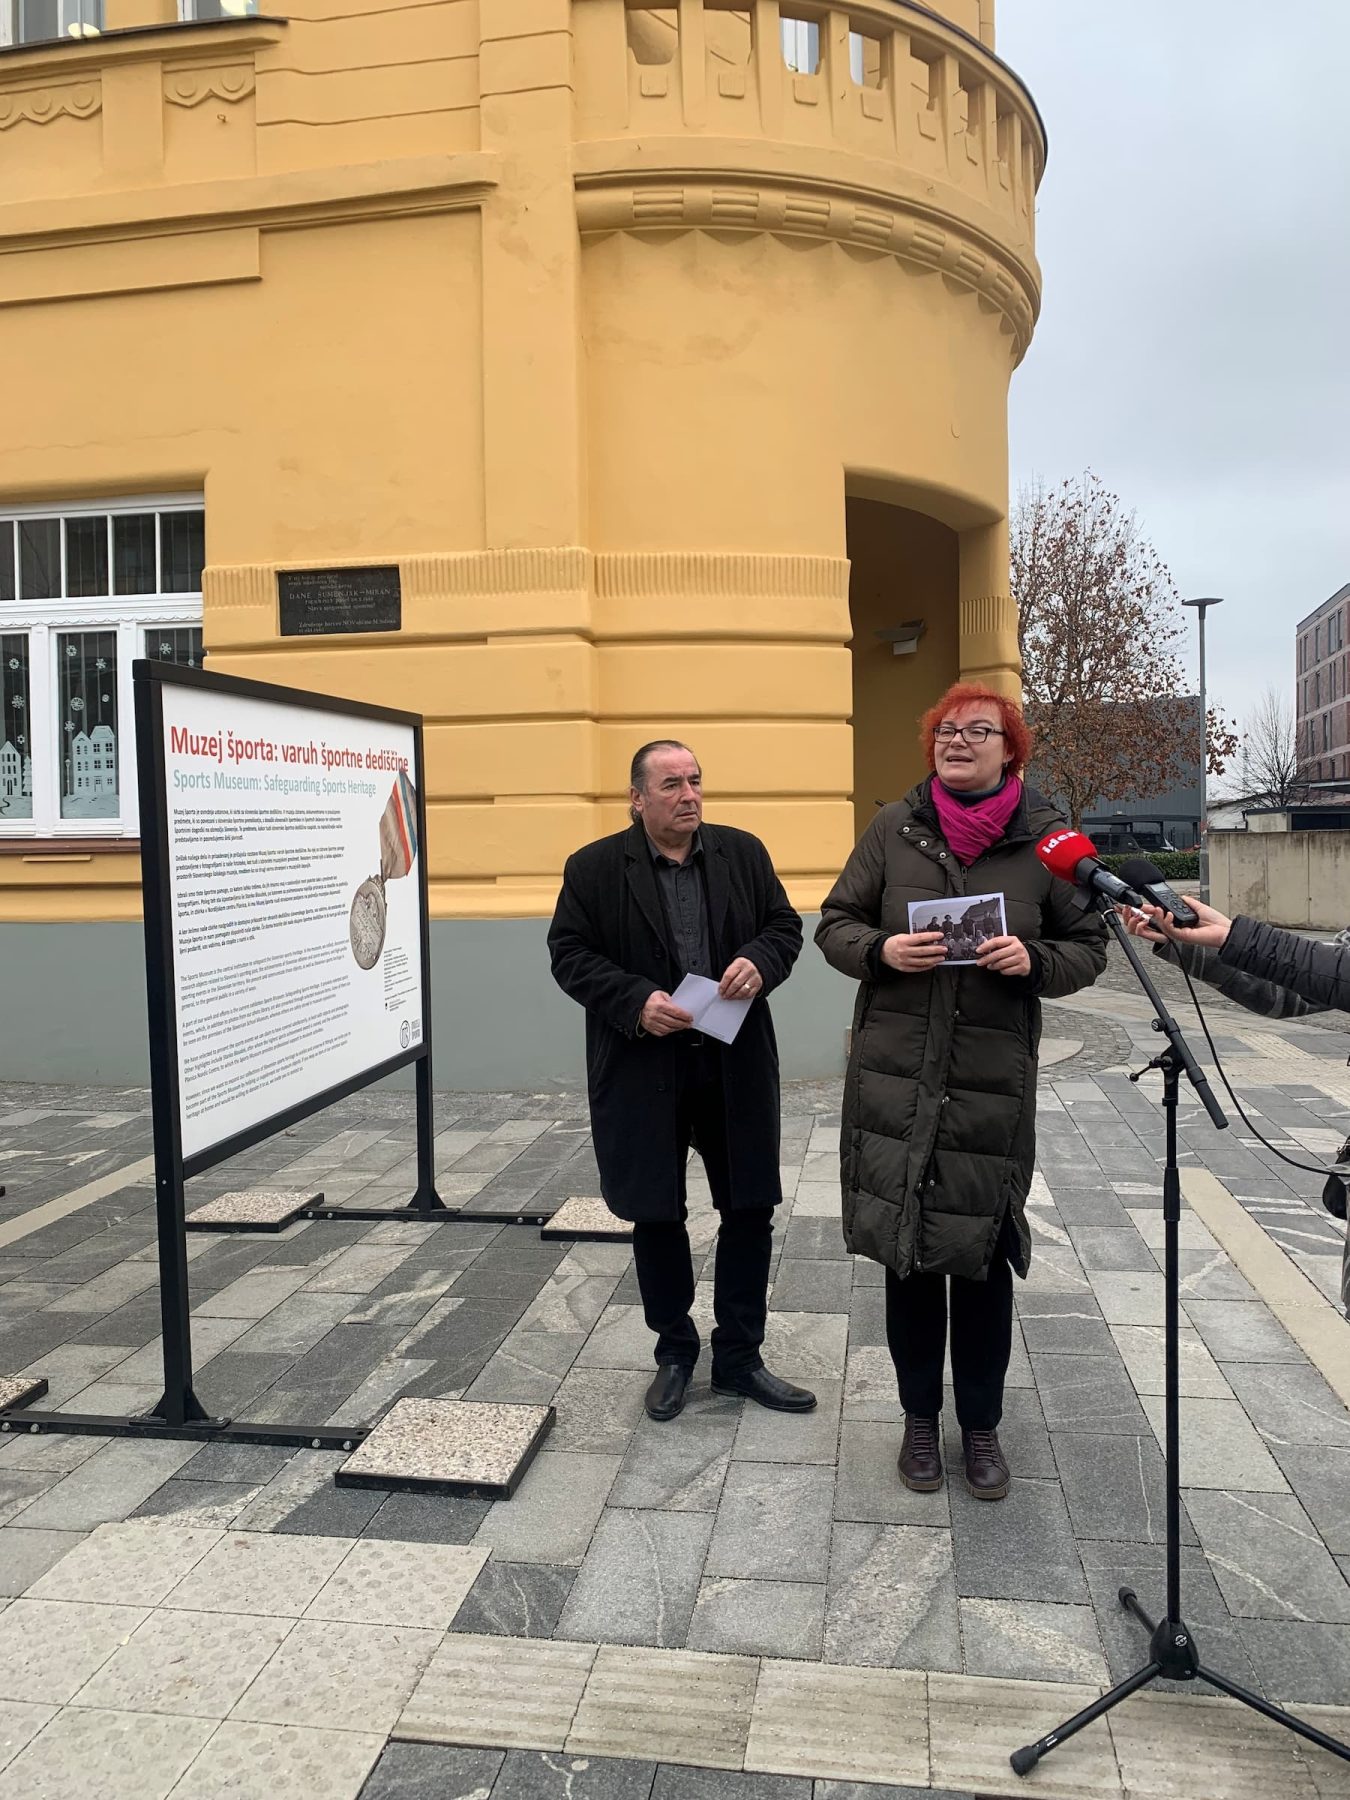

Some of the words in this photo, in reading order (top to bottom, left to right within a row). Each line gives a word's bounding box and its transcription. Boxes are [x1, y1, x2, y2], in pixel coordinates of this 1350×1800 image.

[171, 725, 223, 764] Muzej
[227, 730, 278, 765] športa:
[281, 741, 318, 766] varuh
[321, 742, 363, 771] športne
[365, 748, 409, 772] dediščine
[173, 769, 211, 791] Sports
[214, 771, 262, 791] Museum:
[264, 774, 321, 795] Safeguarding
[322, 777, 346, 795] Sports
[347, 778, 377, 798] Heritage
[1041, 830, 1079, 854] idea
